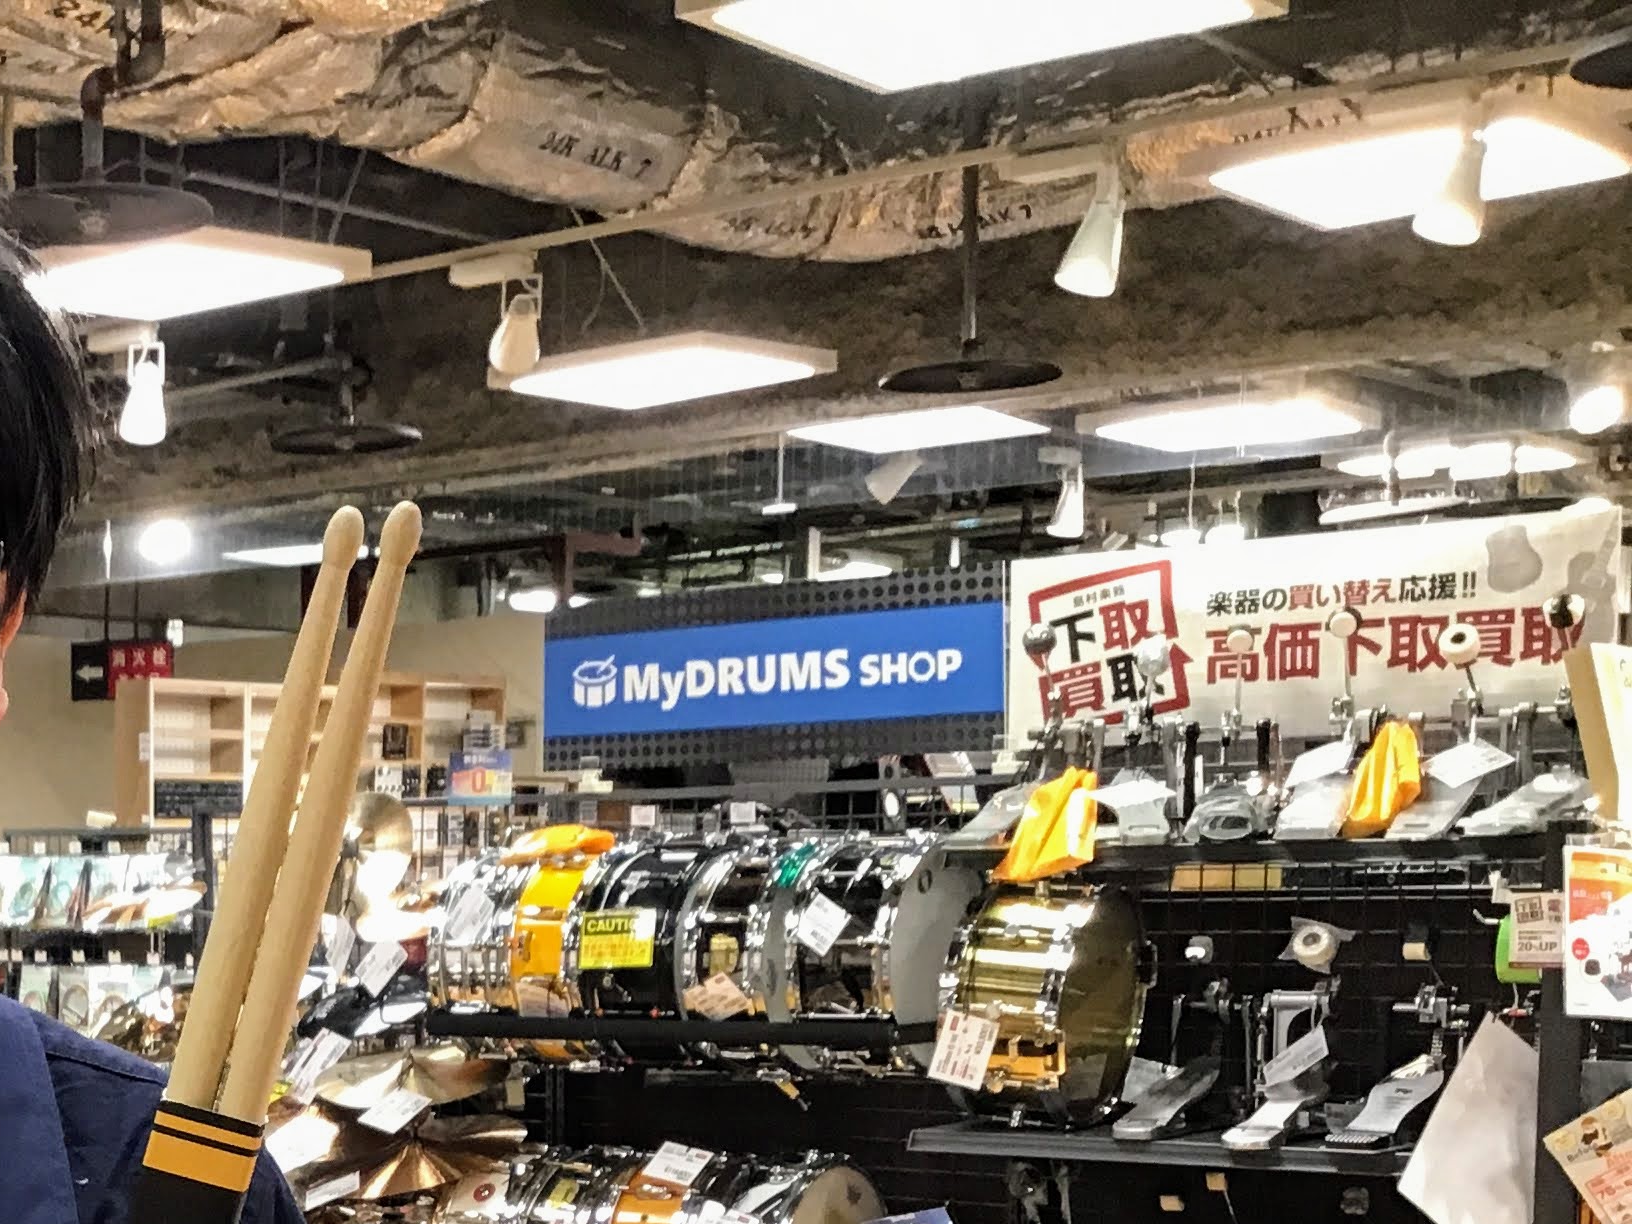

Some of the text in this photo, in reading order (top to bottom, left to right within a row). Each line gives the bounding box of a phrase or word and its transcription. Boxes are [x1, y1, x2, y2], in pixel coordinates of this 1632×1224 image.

[1051, 599, 1151, 664] 下取
[112, 646, 166, 667] 消火栓
[623, 648, 963, 711] MyDRUMS SHOP
[587, 918, 635, 932] CAUTI
